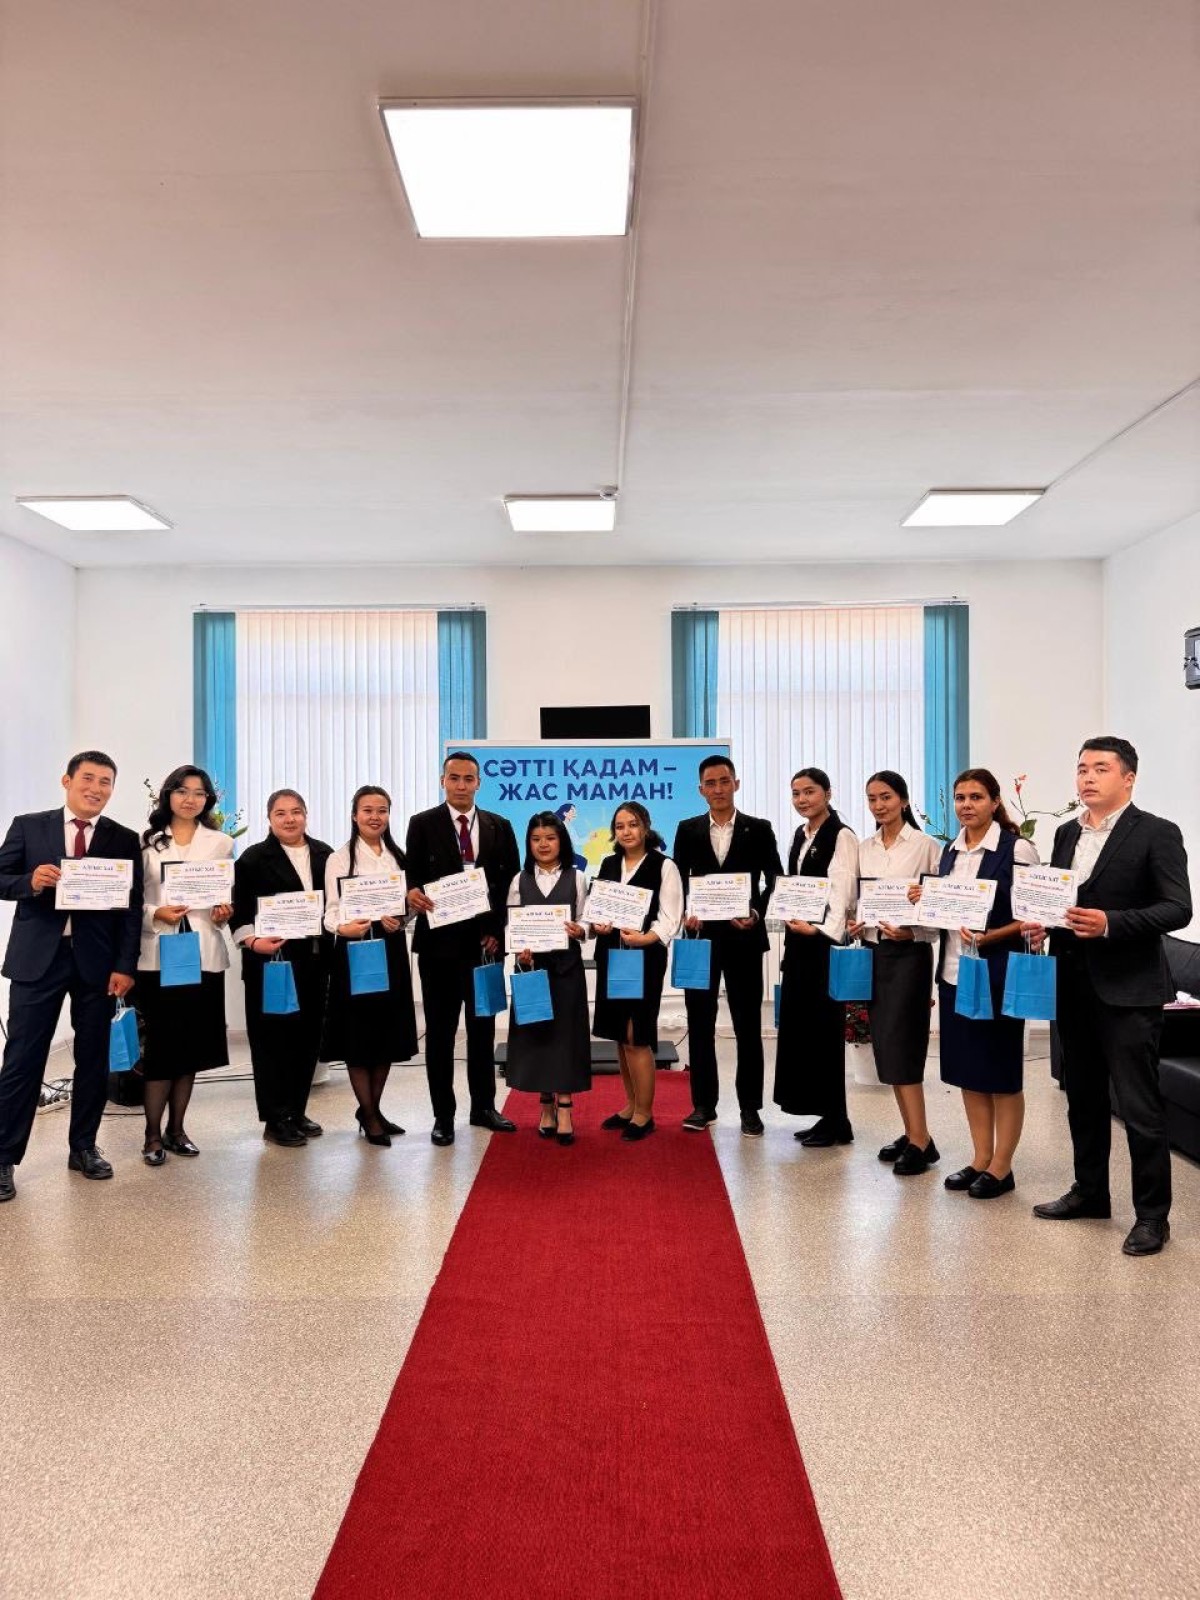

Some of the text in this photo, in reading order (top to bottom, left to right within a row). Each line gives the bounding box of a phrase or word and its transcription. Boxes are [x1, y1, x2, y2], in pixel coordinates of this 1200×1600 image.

[483, 759, 554, 777] СӘТТІ
[563, 759, 658, 779] ҚАДАМ
[499, 782, 673, 801] ЖАС МАМАН!
